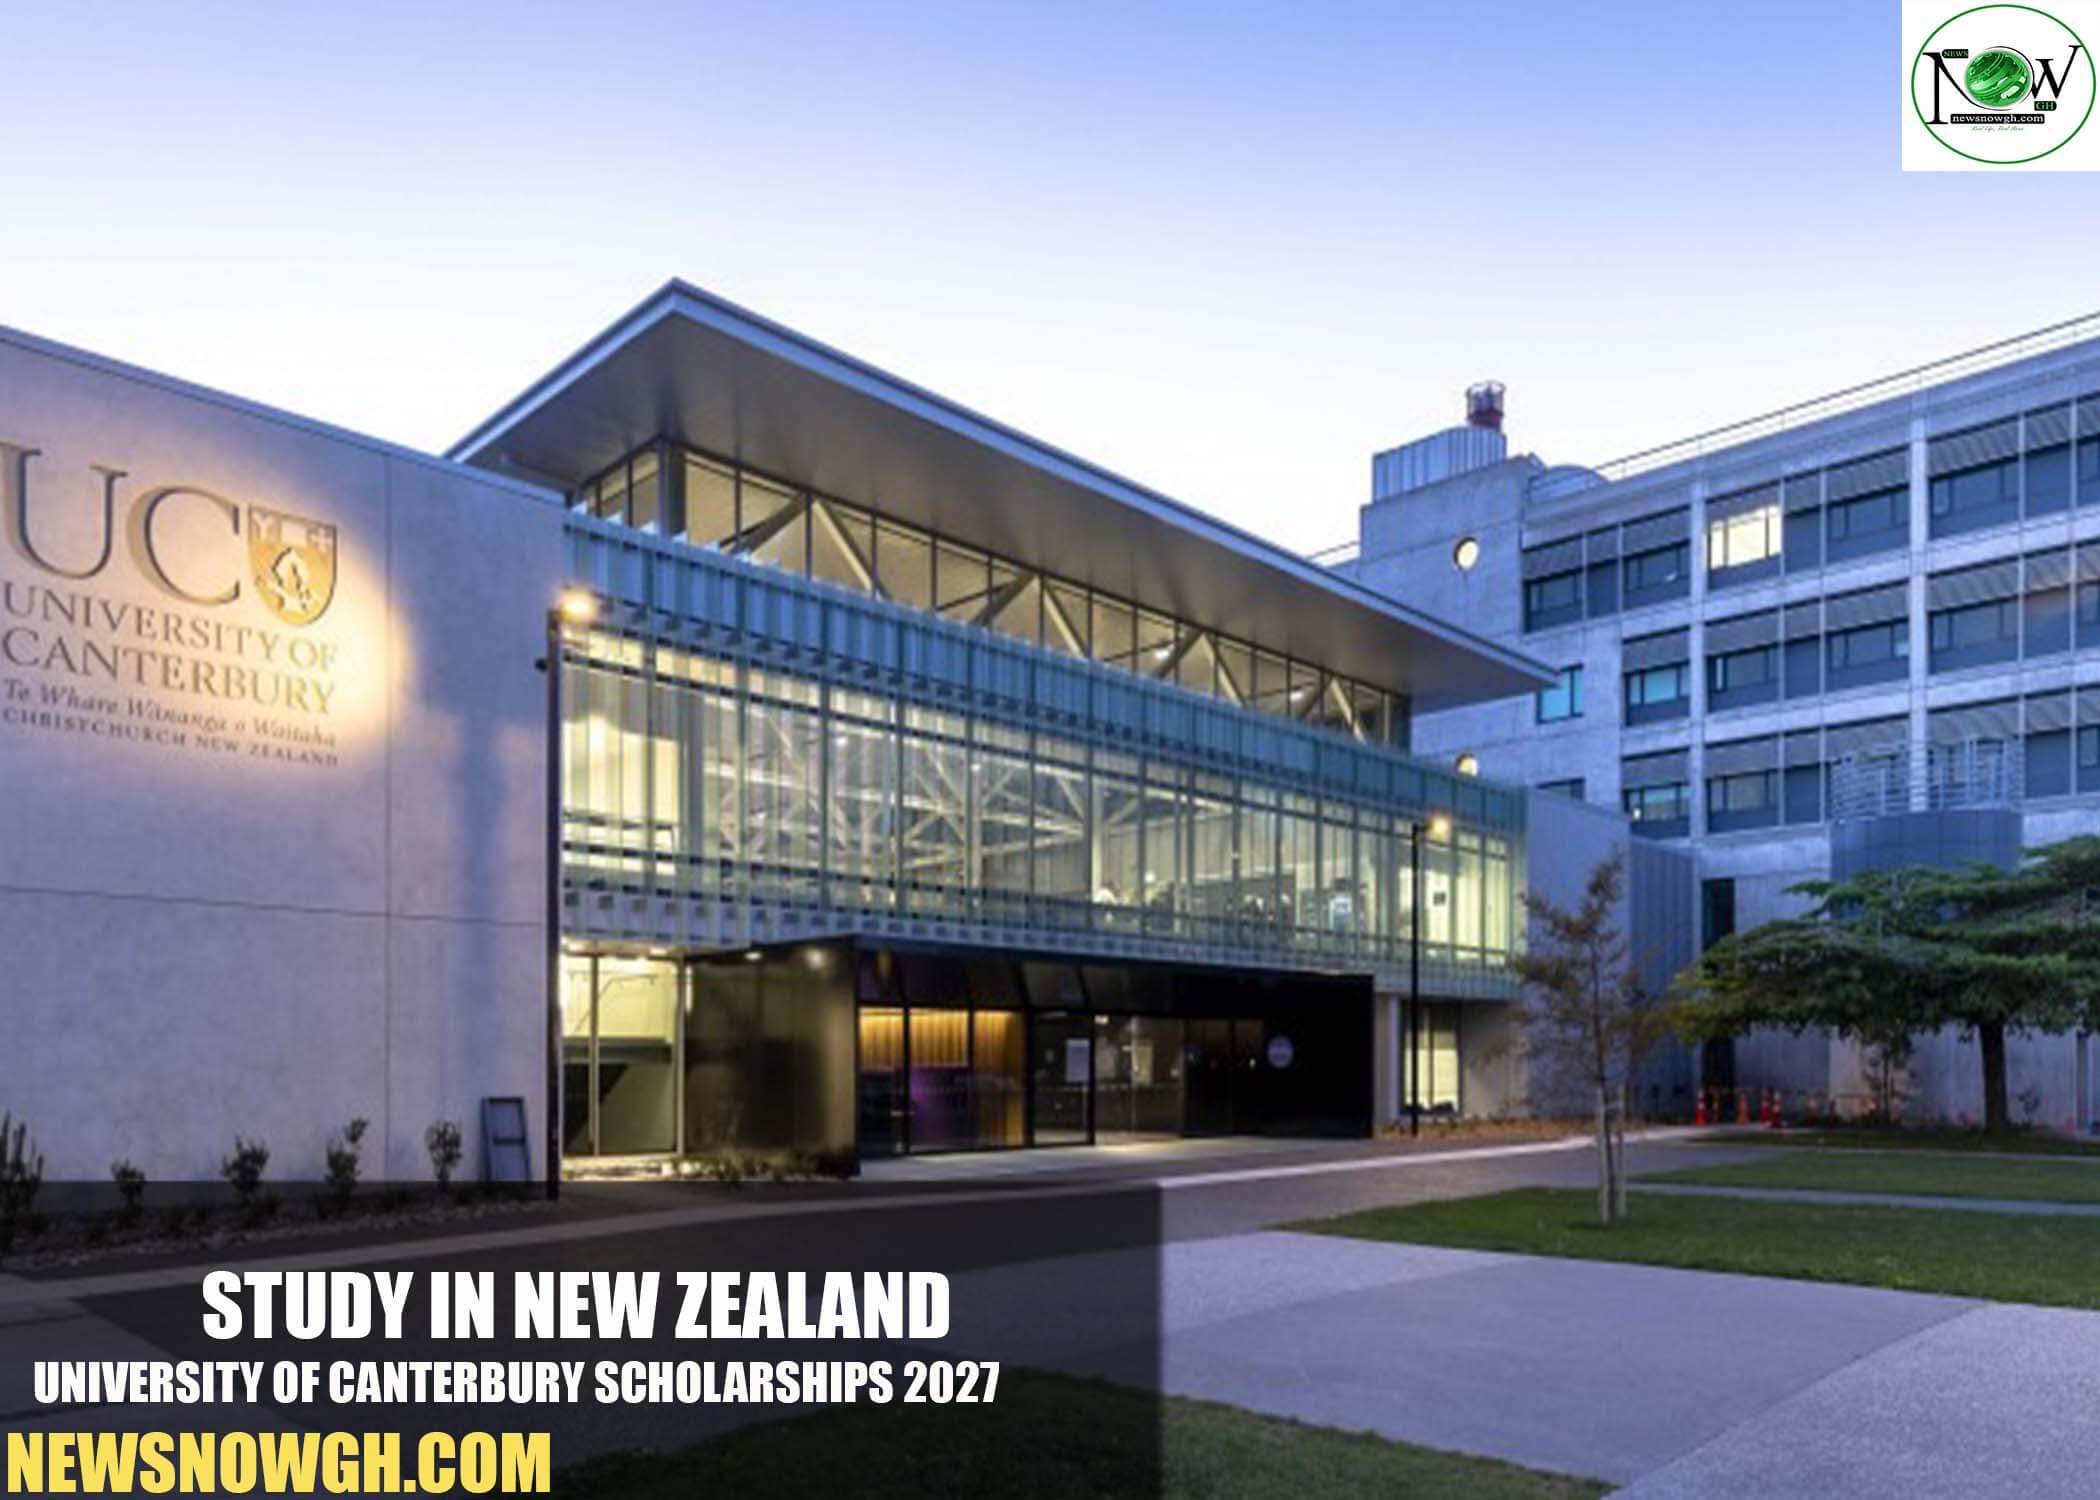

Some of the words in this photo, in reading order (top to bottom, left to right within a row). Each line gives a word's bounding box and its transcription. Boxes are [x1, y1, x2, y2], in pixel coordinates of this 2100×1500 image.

[0, 442, 241, 606] UC
[3, 580, 279, 662] UNIVERSITY
[288, 637, 337, 672] OF
[2, 627, 337, 715] CANTERBURY
[4, 678, 30, 701] Te
[40, 682, 119, 715] Whare
[3, 707, 186, 746] CHRISTCHURCH
[195, 734, 239, 753] NEW
[249, 743, 339, 767] ZEALAND
